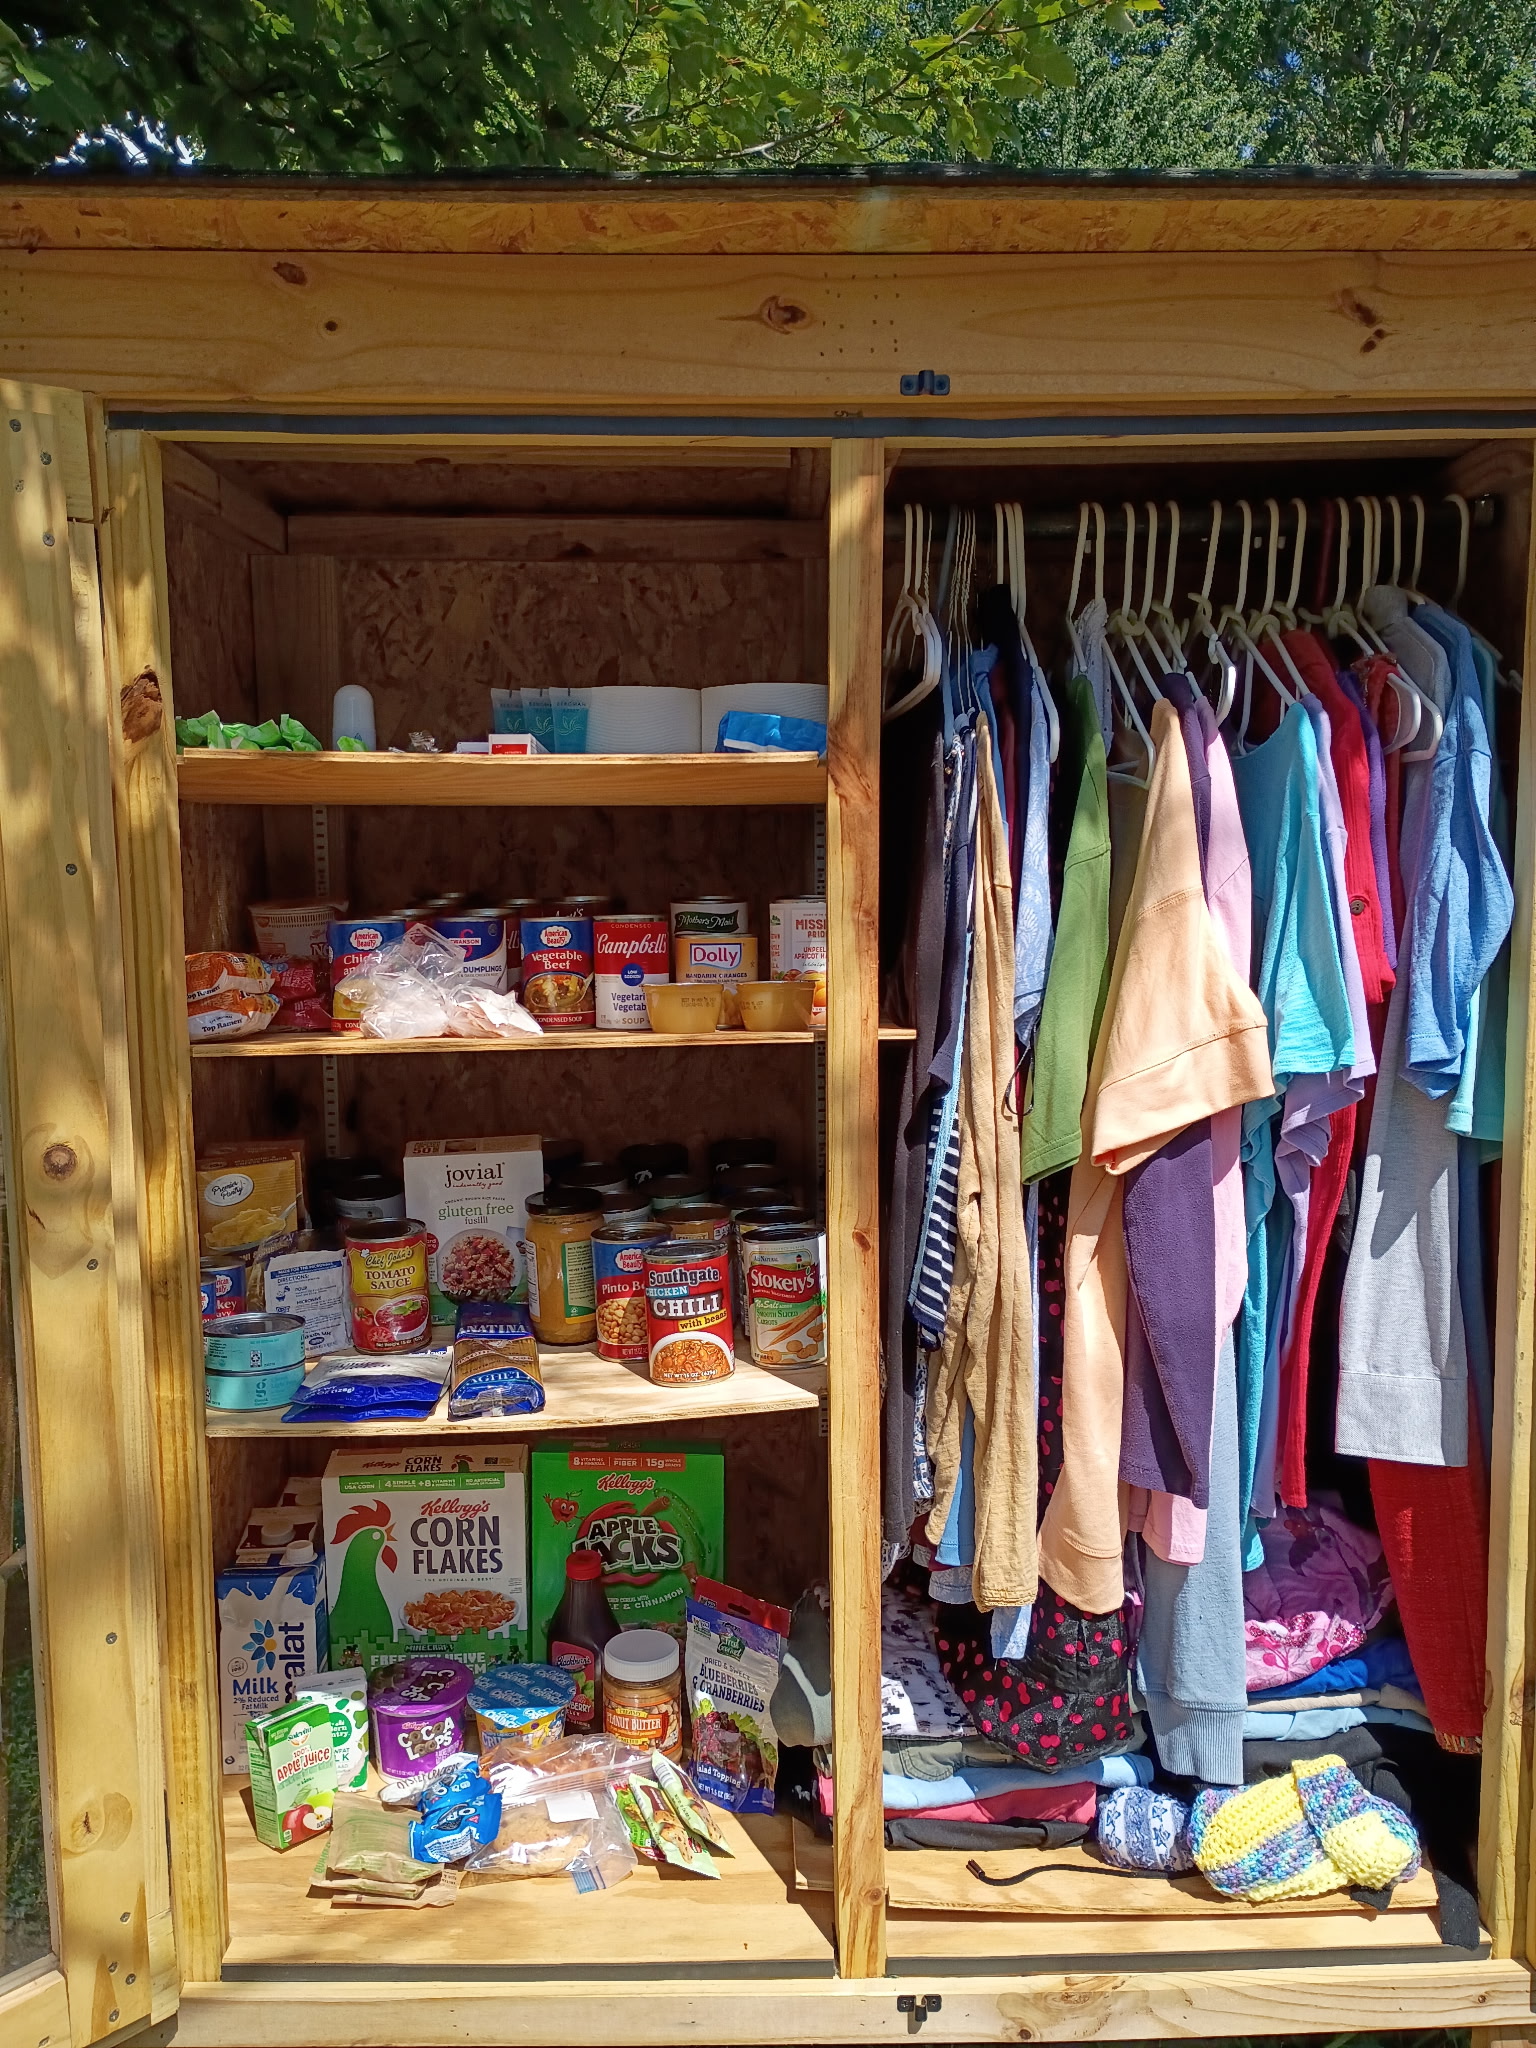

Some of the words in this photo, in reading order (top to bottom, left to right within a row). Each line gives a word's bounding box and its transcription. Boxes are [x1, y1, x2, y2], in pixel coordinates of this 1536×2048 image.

[707, 915, 734, 928] Maid
[796, 919, 826, 930] MISSI
[354, 931, 379, 941] American
[545, 929, 567, 938] American
[807, 930, 825, 939] PRID
[356, 940, 377, 949] Beauty
[547, 937, 566, 945] Beauty
[597, 933, 667, 958] Campbell's
[531, 951, 582, 963] Vegetable
[693, 946, 738, 966] Dolly
[463, 966, 502, 974] DUMPLINGS
[544, 961, 570, 970] Beef
[611, 992, 645, 1004] Vegetari
[613, 1002, 646, 1013] Vegetab
[202, 1023, 216, 1032] Top
[217, 1019, 242, 1029] Ramen
[445, 1163, 504, 1188] jovial
[438, 1205, 482, 1221] gluten
[486, 1203, 514, 1217] free
[465, 1216, 489, 1225] fusilli
[365, 1254, 386, 1268] Chef
[386, 1248, 412, 1265] John's
[620, 1252, 642, 1261] America
[364, 1265, 415, 1280] TOMATO
[649, 1267, 719, 1286] Southgate
[278, 1274, 309, 1284] DIRECTIONS:
[370, 1277, 412, 1290] SAUCE
[751, 1269, 815, 1293] Stokely's
[602, 1283, 629, 1294] Pinto
[646, 1286, 688, 1297] CHICKEN
[217, 1299, 237, 1310] key
[653, 1294, 720, 1317] CHILI
[680, 1319, 702, 1331] with
[705, 1311, 727, 1324] beans
[406, 1456, 442, 1465] CORN
[573, 1457, 580, 1466] 8
[646, 1458, 664, 1468] 15g
[404, 1464, 441, 1473] FLAKES
[597, 1473, 655, 1495] Kellogg's
[421, 1498, 490, 1518] Kellogg's
[410, 1516, 500, 1547] CORN
[588, 1517, 655, 1541] APPLE
[413, 1548, 503, 1575] FLAKES
[635, 1587, 684, 1609] CINNAMON
[405, 1643, 454, 1653] MINECRAFT
[371, 1654, 406, 1666] FREE
[704, 1657, 722, 1667] DRIED
[700, 1664, 759, 1696] BLUEBERRIES
[233, 1677, 279, 1696] Milk
[247, 1695, 279, 1703] Reduced
[700, 1680, 765, 1713] CRANBERRIES
[253, 1702, 268, 1710] Milk
[568, 1701, 592, 1713] BERRY
[607, 1713, 630, 1730] PEANUT
[631, 1718, 661, 1731] BUTTER
[398, 1717, 455, 1748] COCOA
[405, 1731, 453, 1761] LOOPS
[335, 1753, 349, 1762] LK
[697, 1765, 711, 1774] alad
[713, 1768, 741, 1788] Topping
